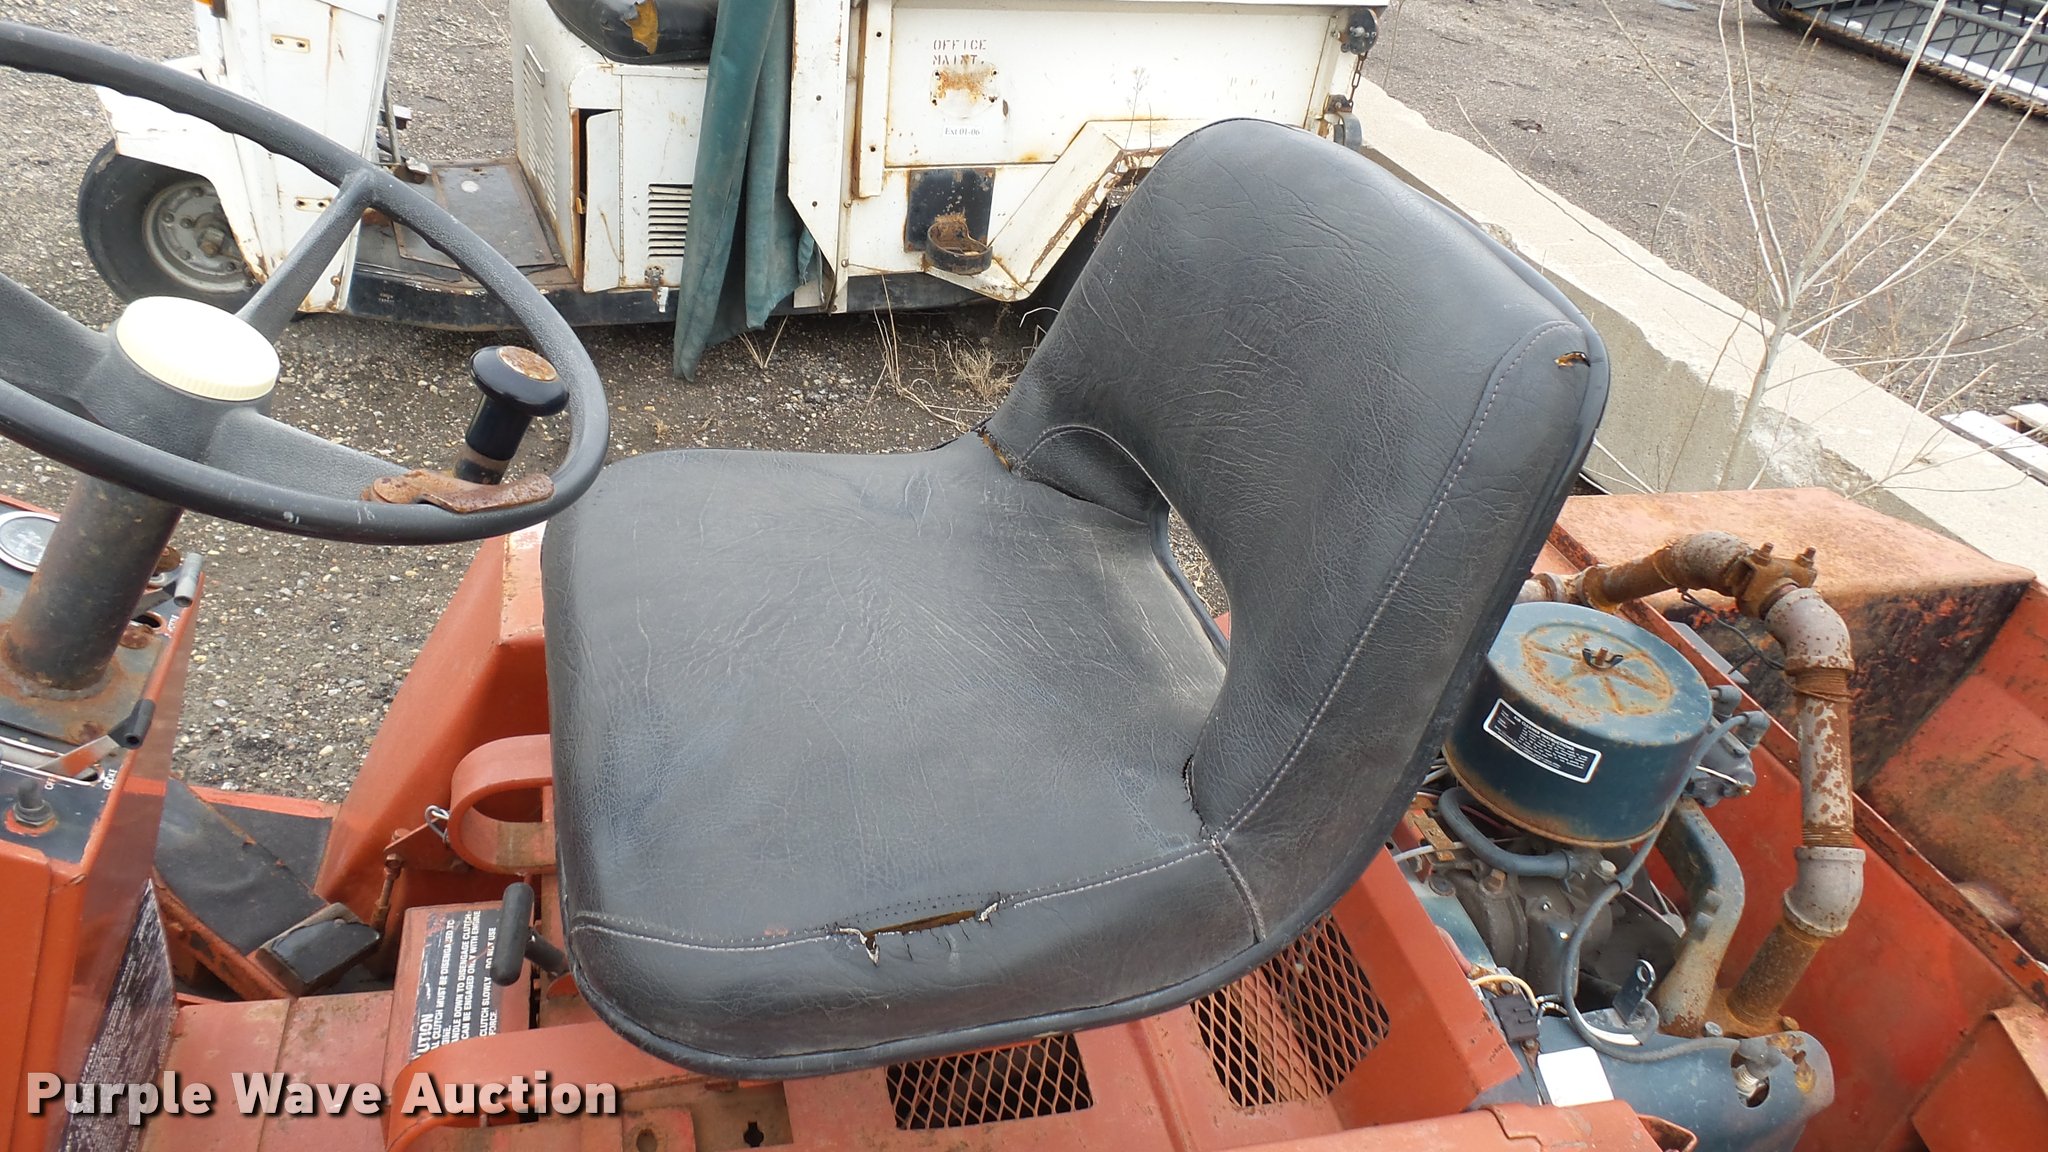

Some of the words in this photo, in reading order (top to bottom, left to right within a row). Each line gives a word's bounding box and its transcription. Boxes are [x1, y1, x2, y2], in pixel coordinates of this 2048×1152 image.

[933, 39, 987, 50] OFFICE
[932, 54, 985, 65] MAINT.
[471, 910, 481, 935] ENGINE
[469, 935, 479, 955] WITH
[458, 940, 470, 981] DISENGAGE
[439, 975, 448, 986] BE
[457, 982, 465, 993] TO
[480, 1007, 490, 1037] CLUTCH
[488, 927, 497, 941] USE
[436, 986, 446, 1009] MUST
[464, 975, 474, 1010] ENGAGED
[454, 993, 464, 1018] DOWN
[432, 1009, 443, 1039] CLUTCH
[463, 1011, 471, 1022] BE
[461, 1022, 470, 1040] CAN
